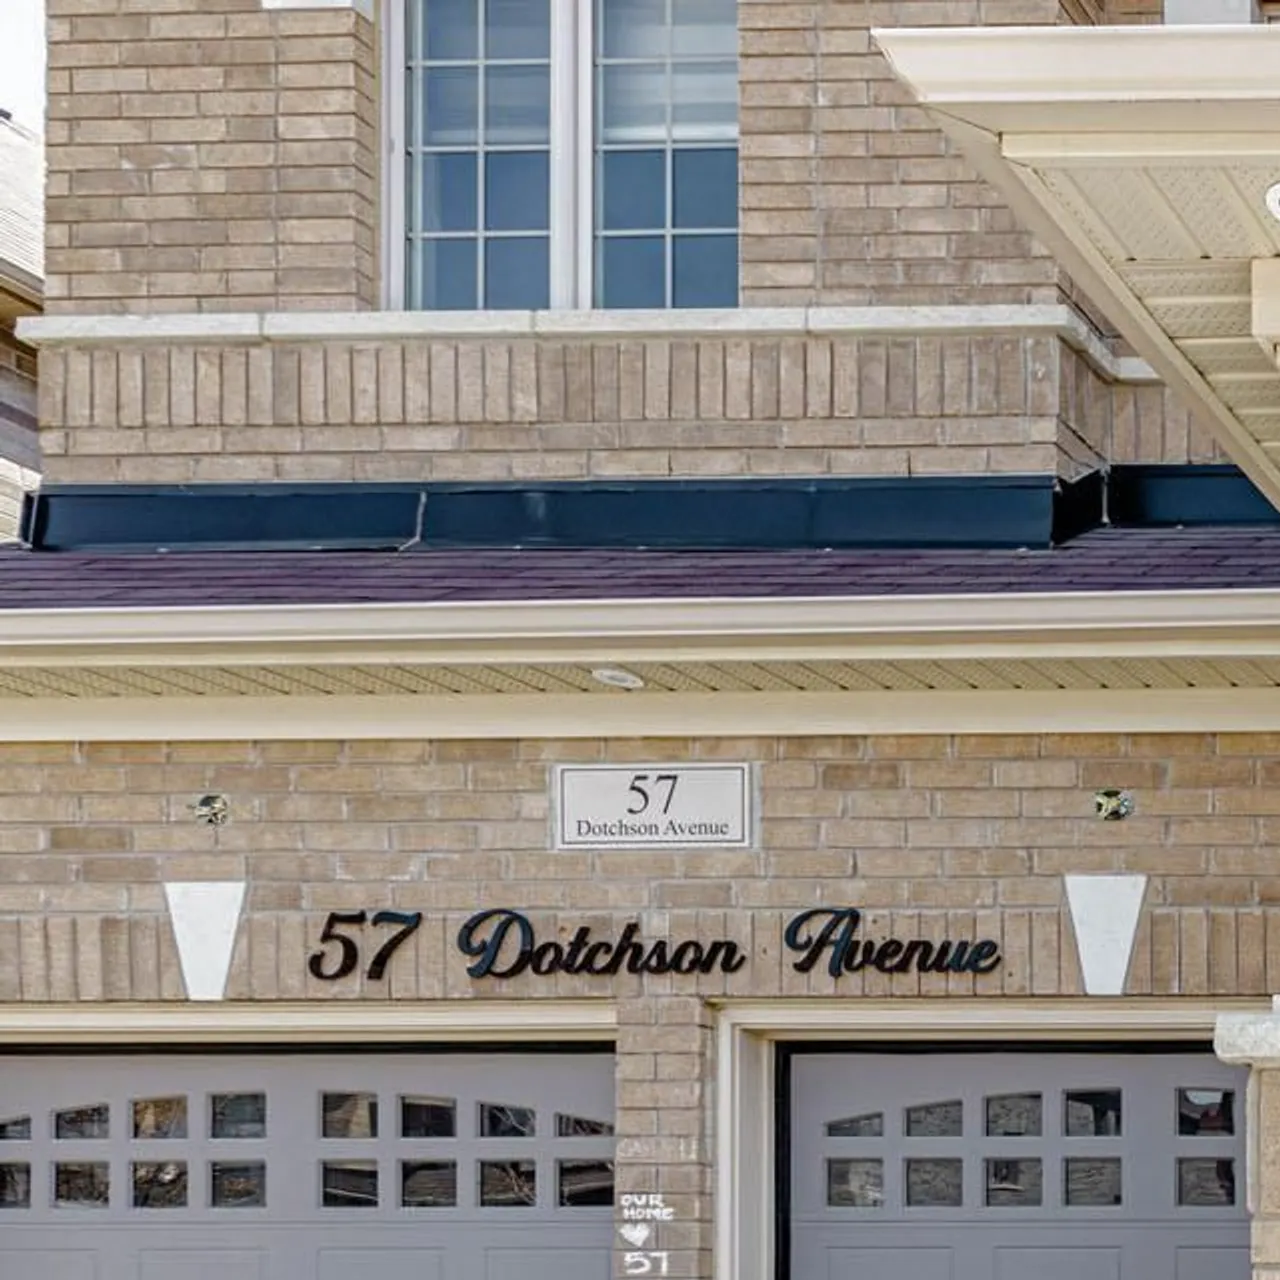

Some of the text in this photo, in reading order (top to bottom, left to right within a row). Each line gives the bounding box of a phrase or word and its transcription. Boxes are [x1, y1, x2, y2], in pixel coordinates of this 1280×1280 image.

[627, 774, 680, 815] 57
[576, 819, 730, 837] Dotchson Avenue
[308, 907, 1002, 981] 57 Dotchson Avenue
[620, 1194, 665, 1208] OUR
[622, 1207, 676, 1220] HOME
[623, 1252, 669, 1276] 57
